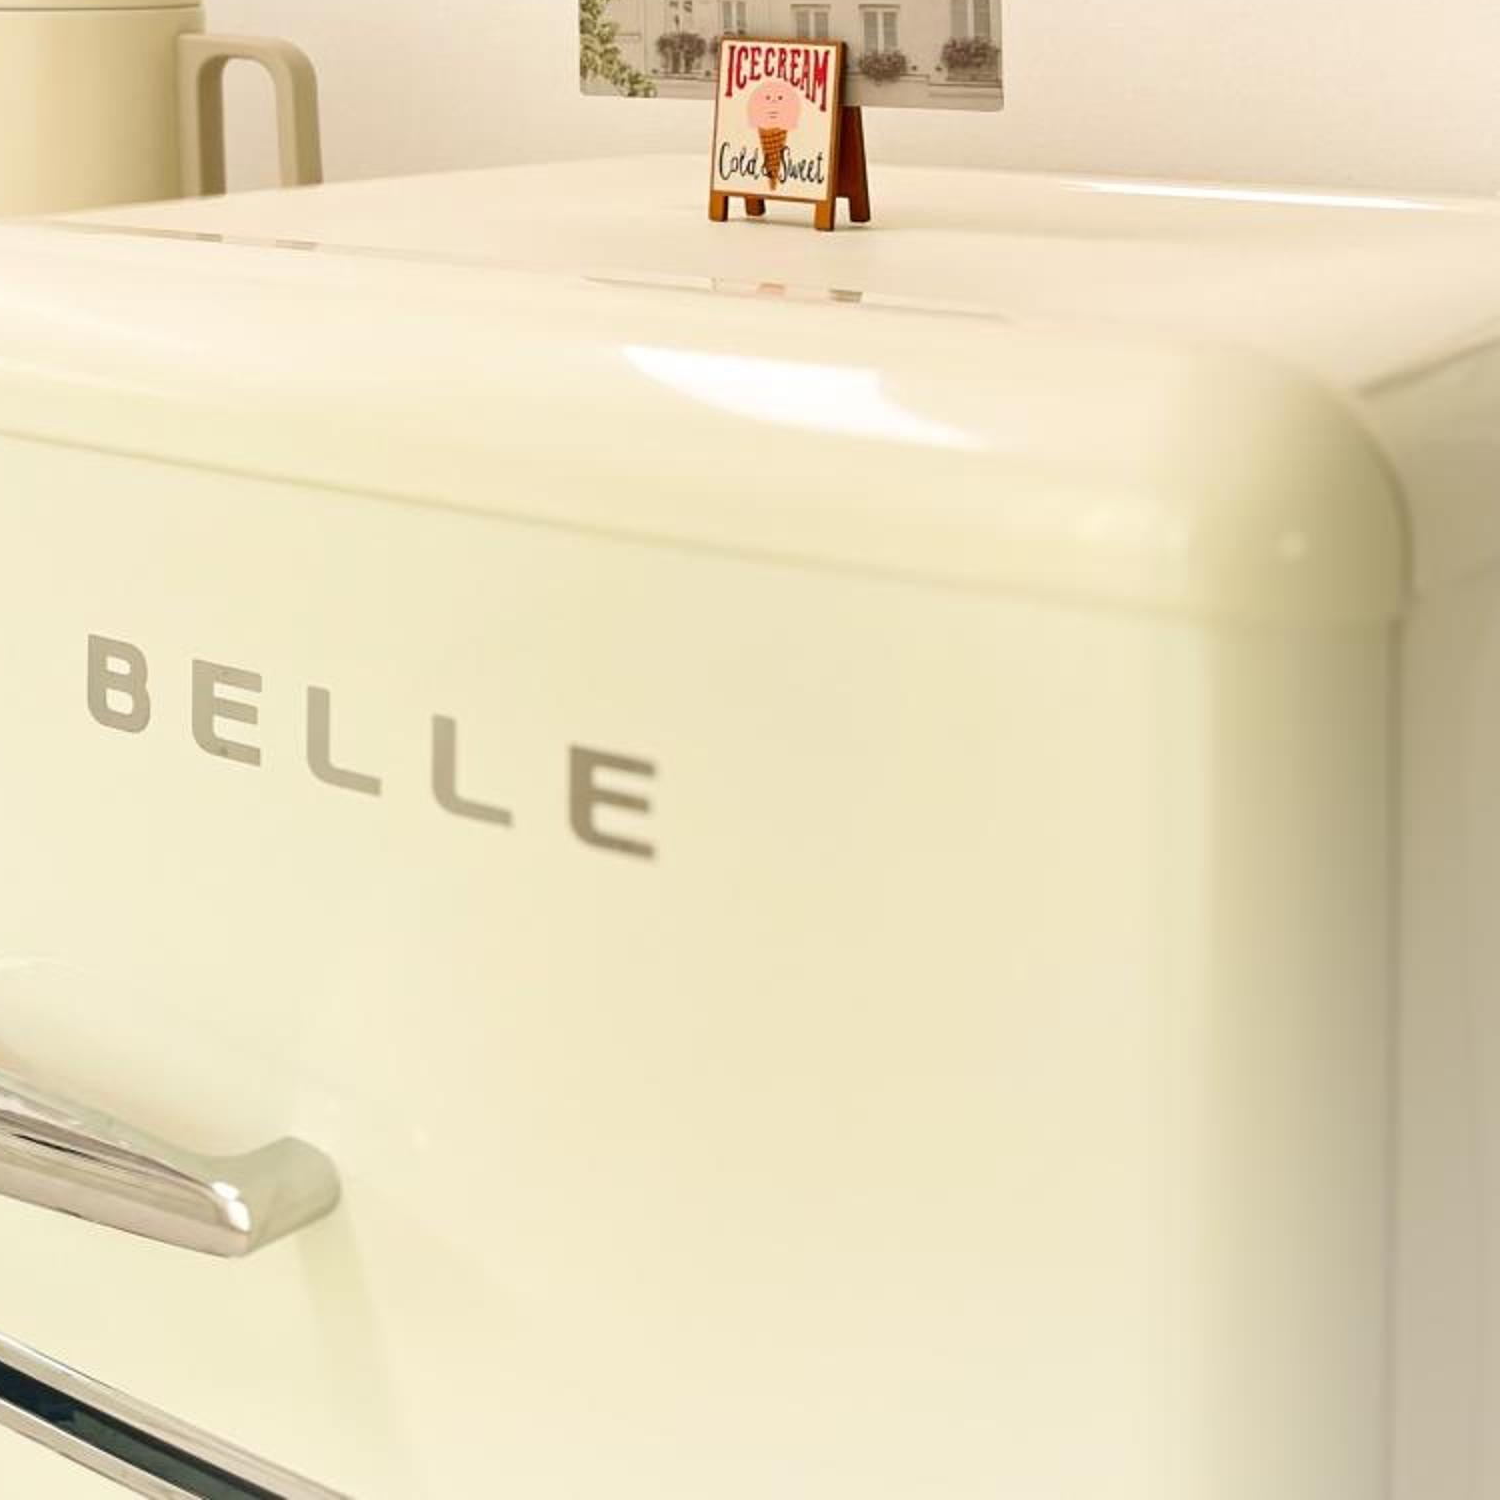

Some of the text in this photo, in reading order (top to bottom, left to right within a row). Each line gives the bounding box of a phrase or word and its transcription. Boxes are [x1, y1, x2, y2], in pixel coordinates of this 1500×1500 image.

[719, 142, 760, 181] Cold
[779, 145, 825, 184] Sweet
[87, 634, 657, 860] BELLE
